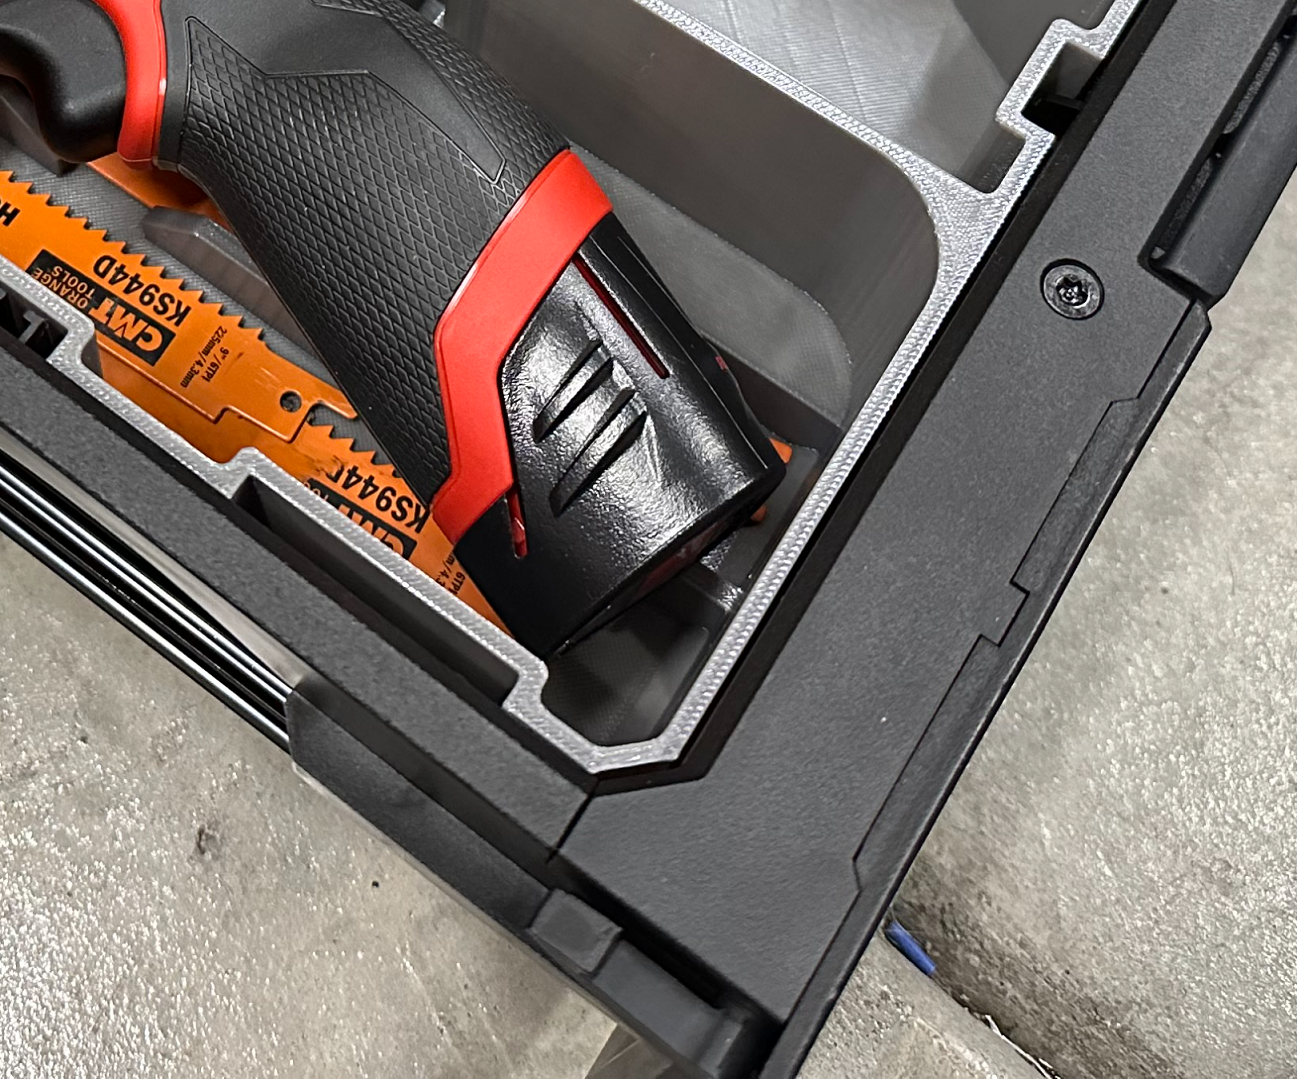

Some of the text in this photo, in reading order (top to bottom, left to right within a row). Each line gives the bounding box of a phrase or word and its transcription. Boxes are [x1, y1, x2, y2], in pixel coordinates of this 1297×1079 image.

[30, 267, 163, 352] CMT ORANGE
[53, 265, 95, 300] TOOLS
[93, 255, 192, 327] KS944D
